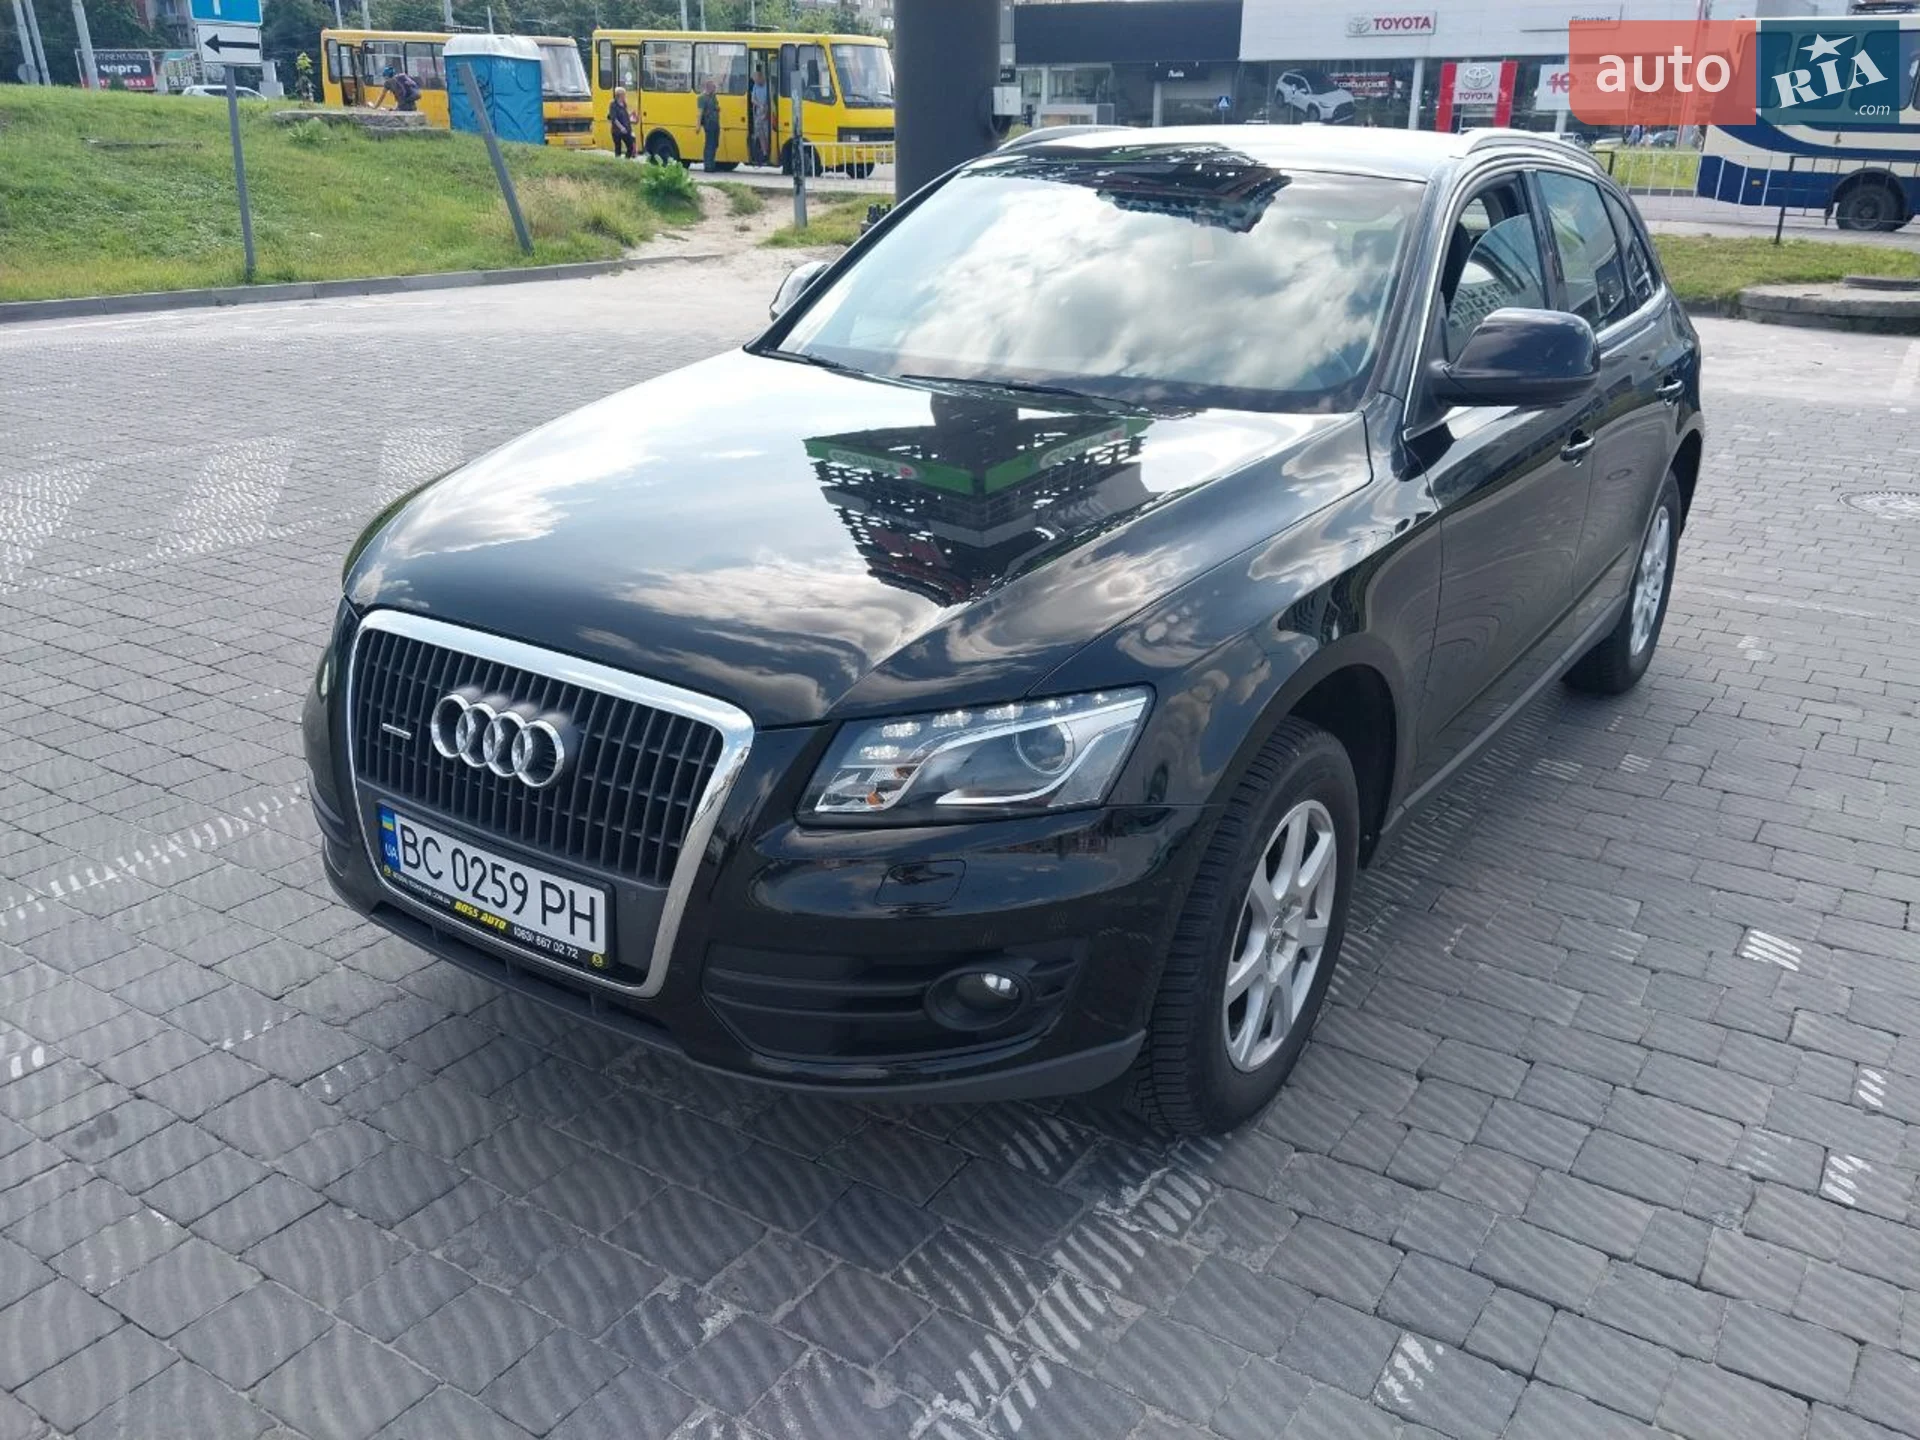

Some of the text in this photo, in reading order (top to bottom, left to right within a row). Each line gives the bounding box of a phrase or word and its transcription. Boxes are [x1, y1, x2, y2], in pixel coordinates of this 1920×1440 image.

[1373, 16, 1432, 31] TOYOTA
[1458, 91, 1494, 101] TOYOTA
[385, 842, 398, 860] UA
[400, 824, 443, 880] BC
[451, 848, 529, 915] 0259
[540, 880, 596, 943] PH
[454, 901, 506, 930] BOSS AUTO
[553, 942, 565, 955] 02
[566, 946, 579, 959] 72
